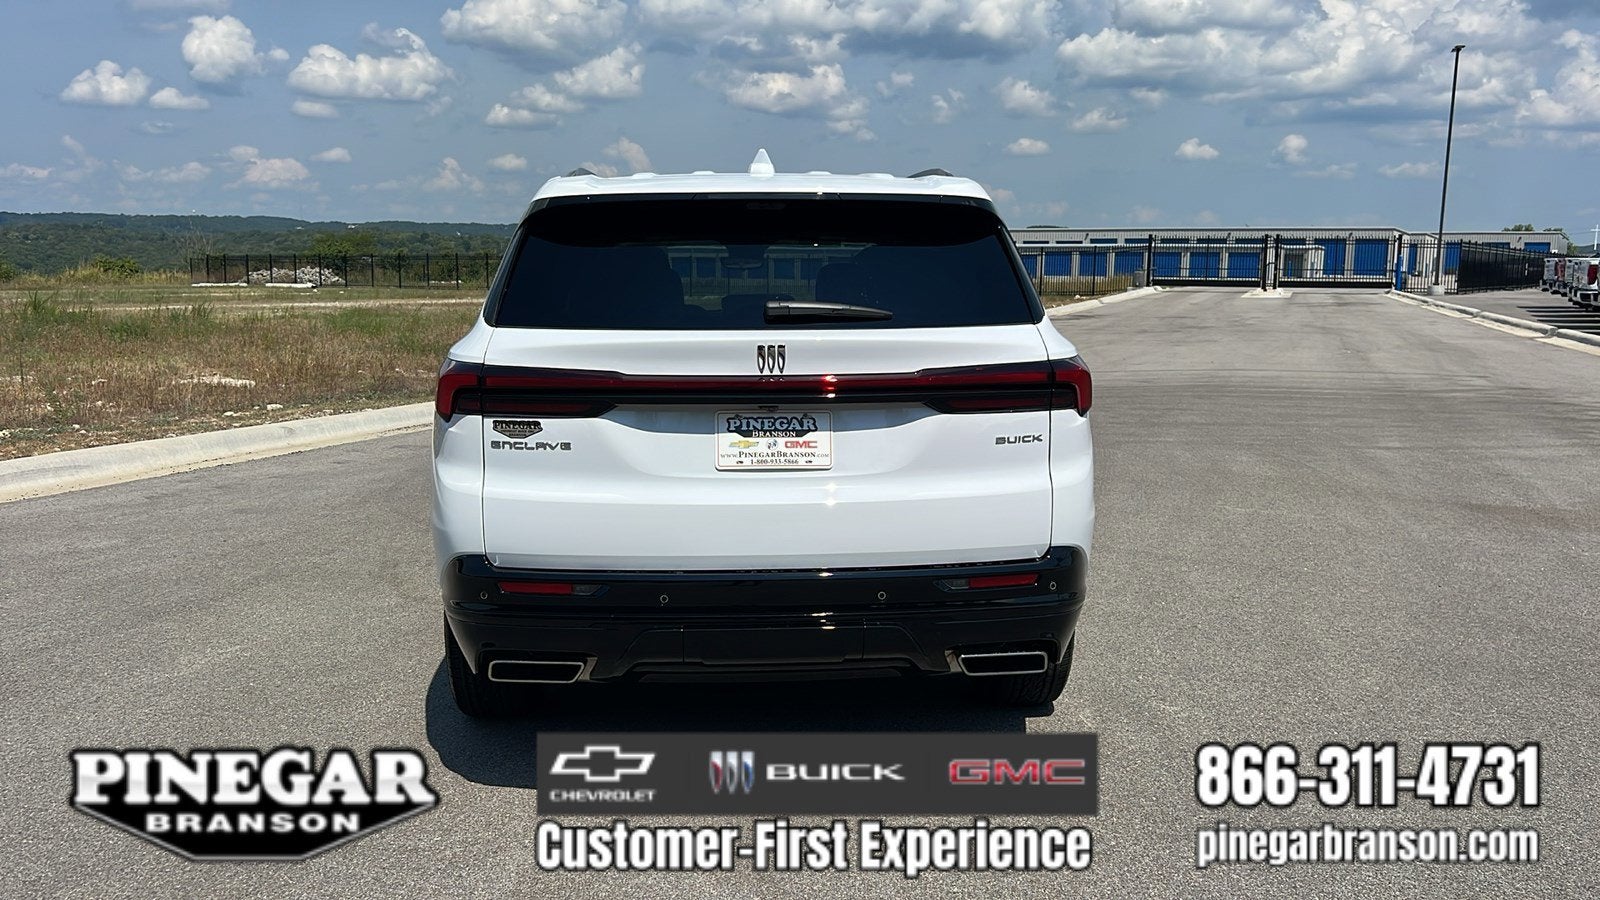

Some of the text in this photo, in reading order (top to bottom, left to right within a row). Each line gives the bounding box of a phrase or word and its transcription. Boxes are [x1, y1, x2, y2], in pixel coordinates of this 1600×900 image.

[728, 418, 816, 431] PINEGAR
[784, 440, 818, 449] GMC
[995, 434, 1043, 445] BUICK
[490, 440, 571, 450] ENCLAVE
